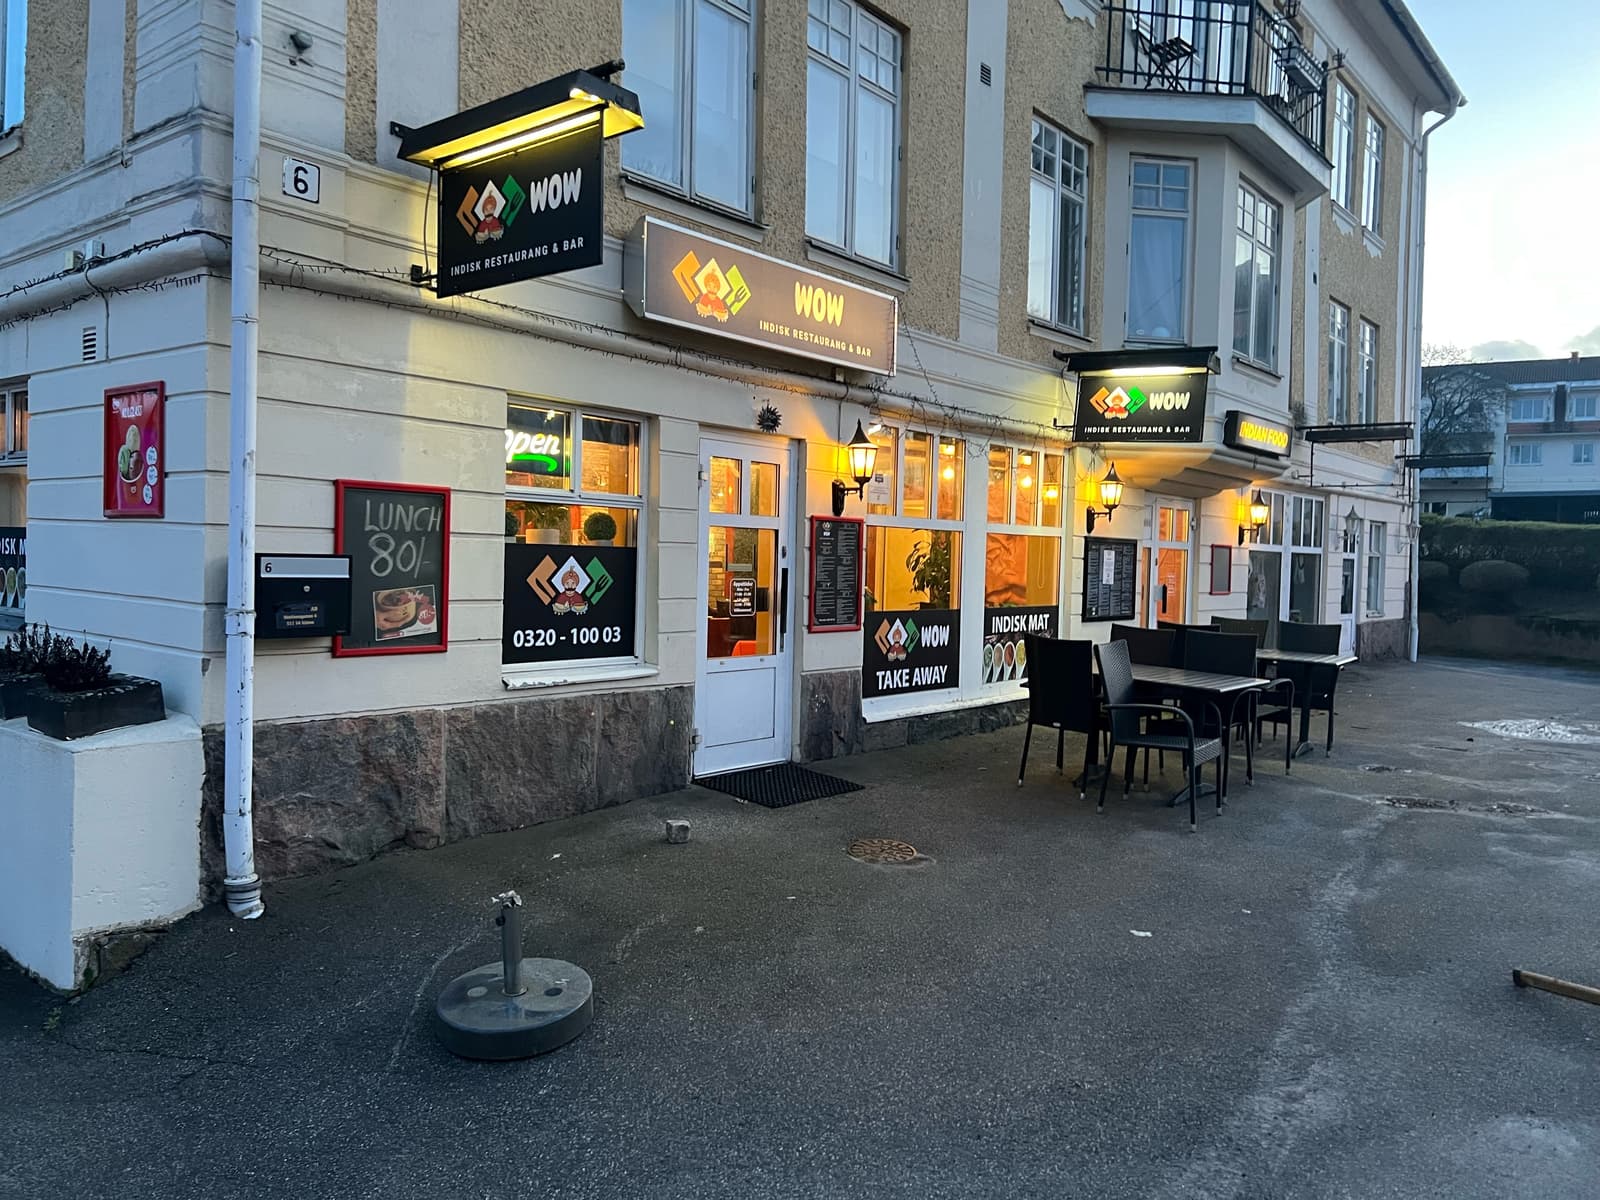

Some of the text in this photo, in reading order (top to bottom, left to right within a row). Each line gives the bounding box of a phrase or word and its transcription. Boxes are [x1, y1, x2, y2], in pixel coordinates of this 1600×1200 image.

[294, 166, 309, 194] 6
[530, 167, 582, 214] WOW
[450, 237, 584, 277] INDISK RESTAURANG & BAR
[794, 280, 844, 327] WOW
[759, 320, 872, 357] INDISK RESTAURANG & BAR
[1149, 391, 1190, 411] WOW
[1084, 426, 1110, 434] INDISK
[1239, 421, 1289, 448] INDIAN FOOD
[364, 499, 442, 532] LUNCH
[0, 537, 16, 555] ISK
[264, 562, 272, 573] 6
[921, 624, 950, 648] WOW
[992, 613, 1050, 634] INDISK MAT
[513, 628, 556, 648] 0320
[570, 627, 599, 645] 100
[602, 626, 621, 643] 03
[876, 665, 948, 690] TAKE AWAY
